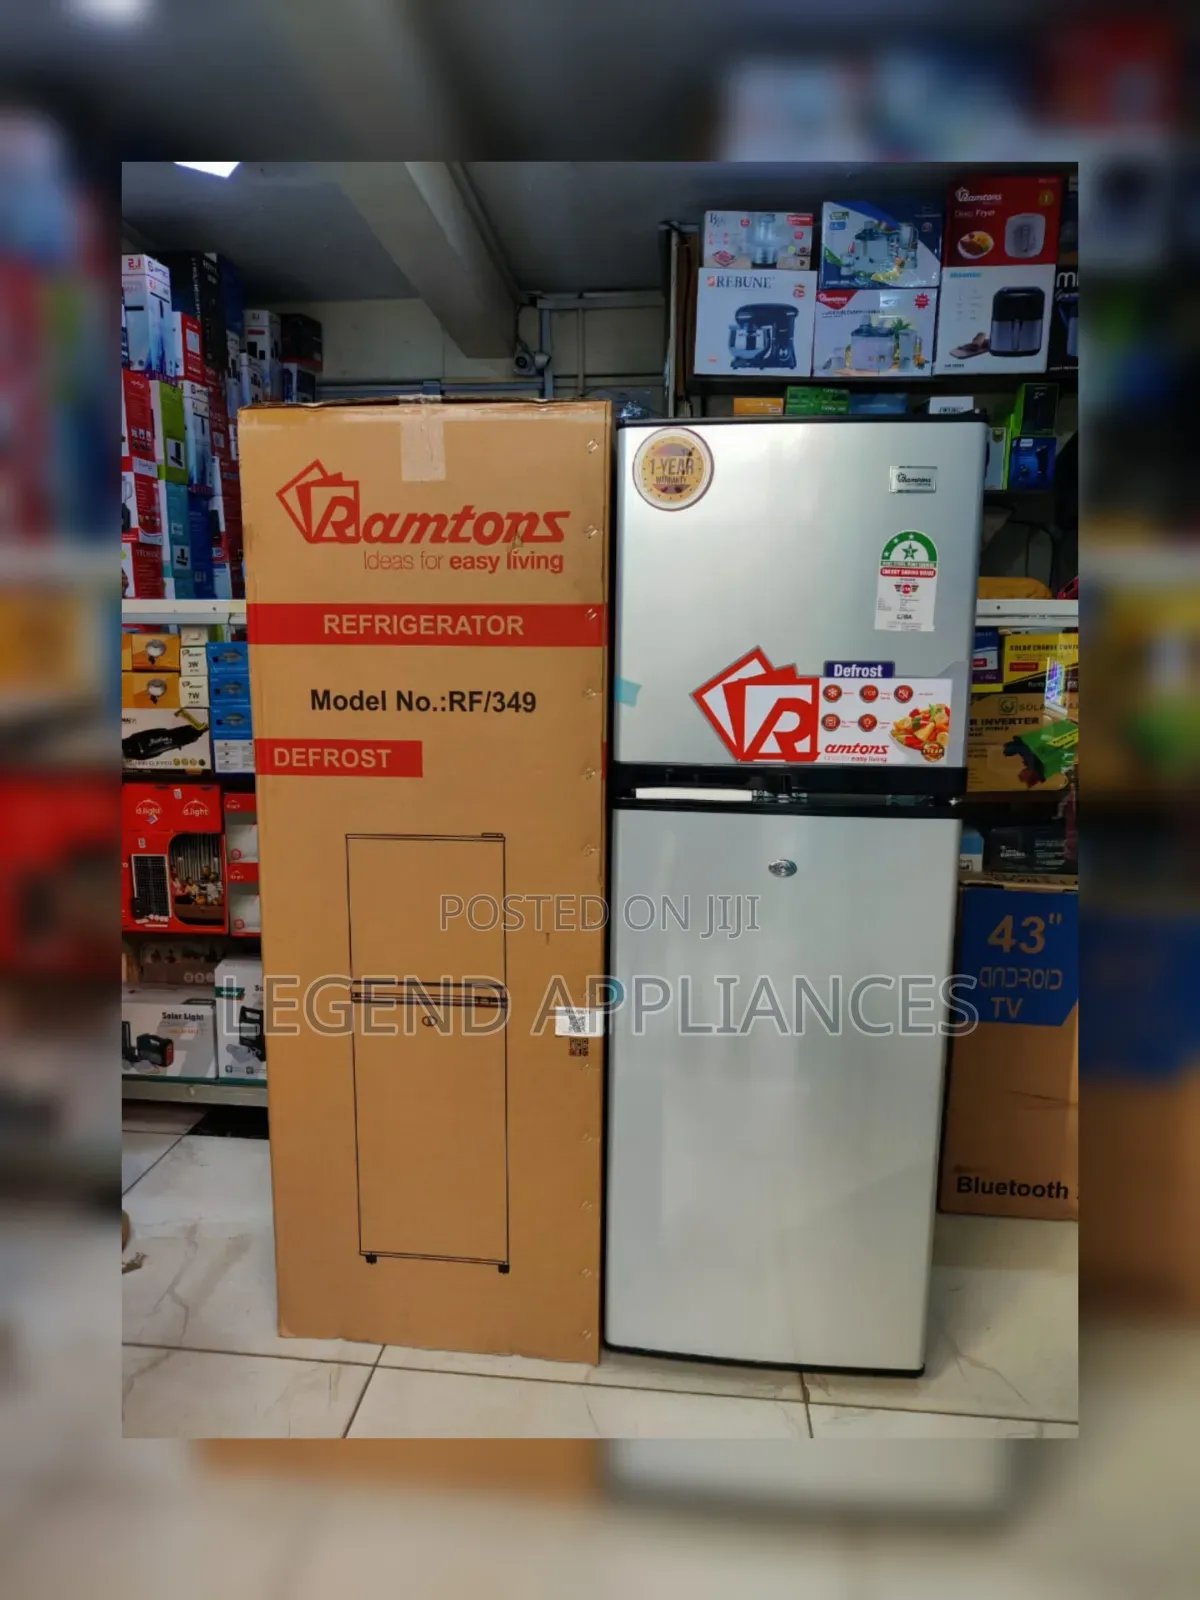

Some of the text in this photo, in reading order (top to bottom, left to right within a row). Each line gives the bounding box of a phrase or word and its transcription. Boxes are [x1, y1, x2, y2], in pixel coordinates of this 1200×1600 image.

[976, 208, 996, 217] Fryer
[716, 275, 772, 288] REBUNE
[308, 480, 571, 546] Ramtons
[363, 550, 565, 574] Ideas for easy living
[323, 613, 525, 636] REFRIGERATOR
[833, 663, 884, 678] Defrost
[310, 689, 387, 712] Model
[981, 717, 1040, 726] INVERTER
[273, 747, 393, 769] DEFROST
[135, 807, 162, 816] d.light
[183, 807, 209, 817] d.light
[161, 1011, 204, 1022] Solar Light
[990, 996, 1024, 1019] TV
[956, 1175, 1069, 1200] Bluetooth
